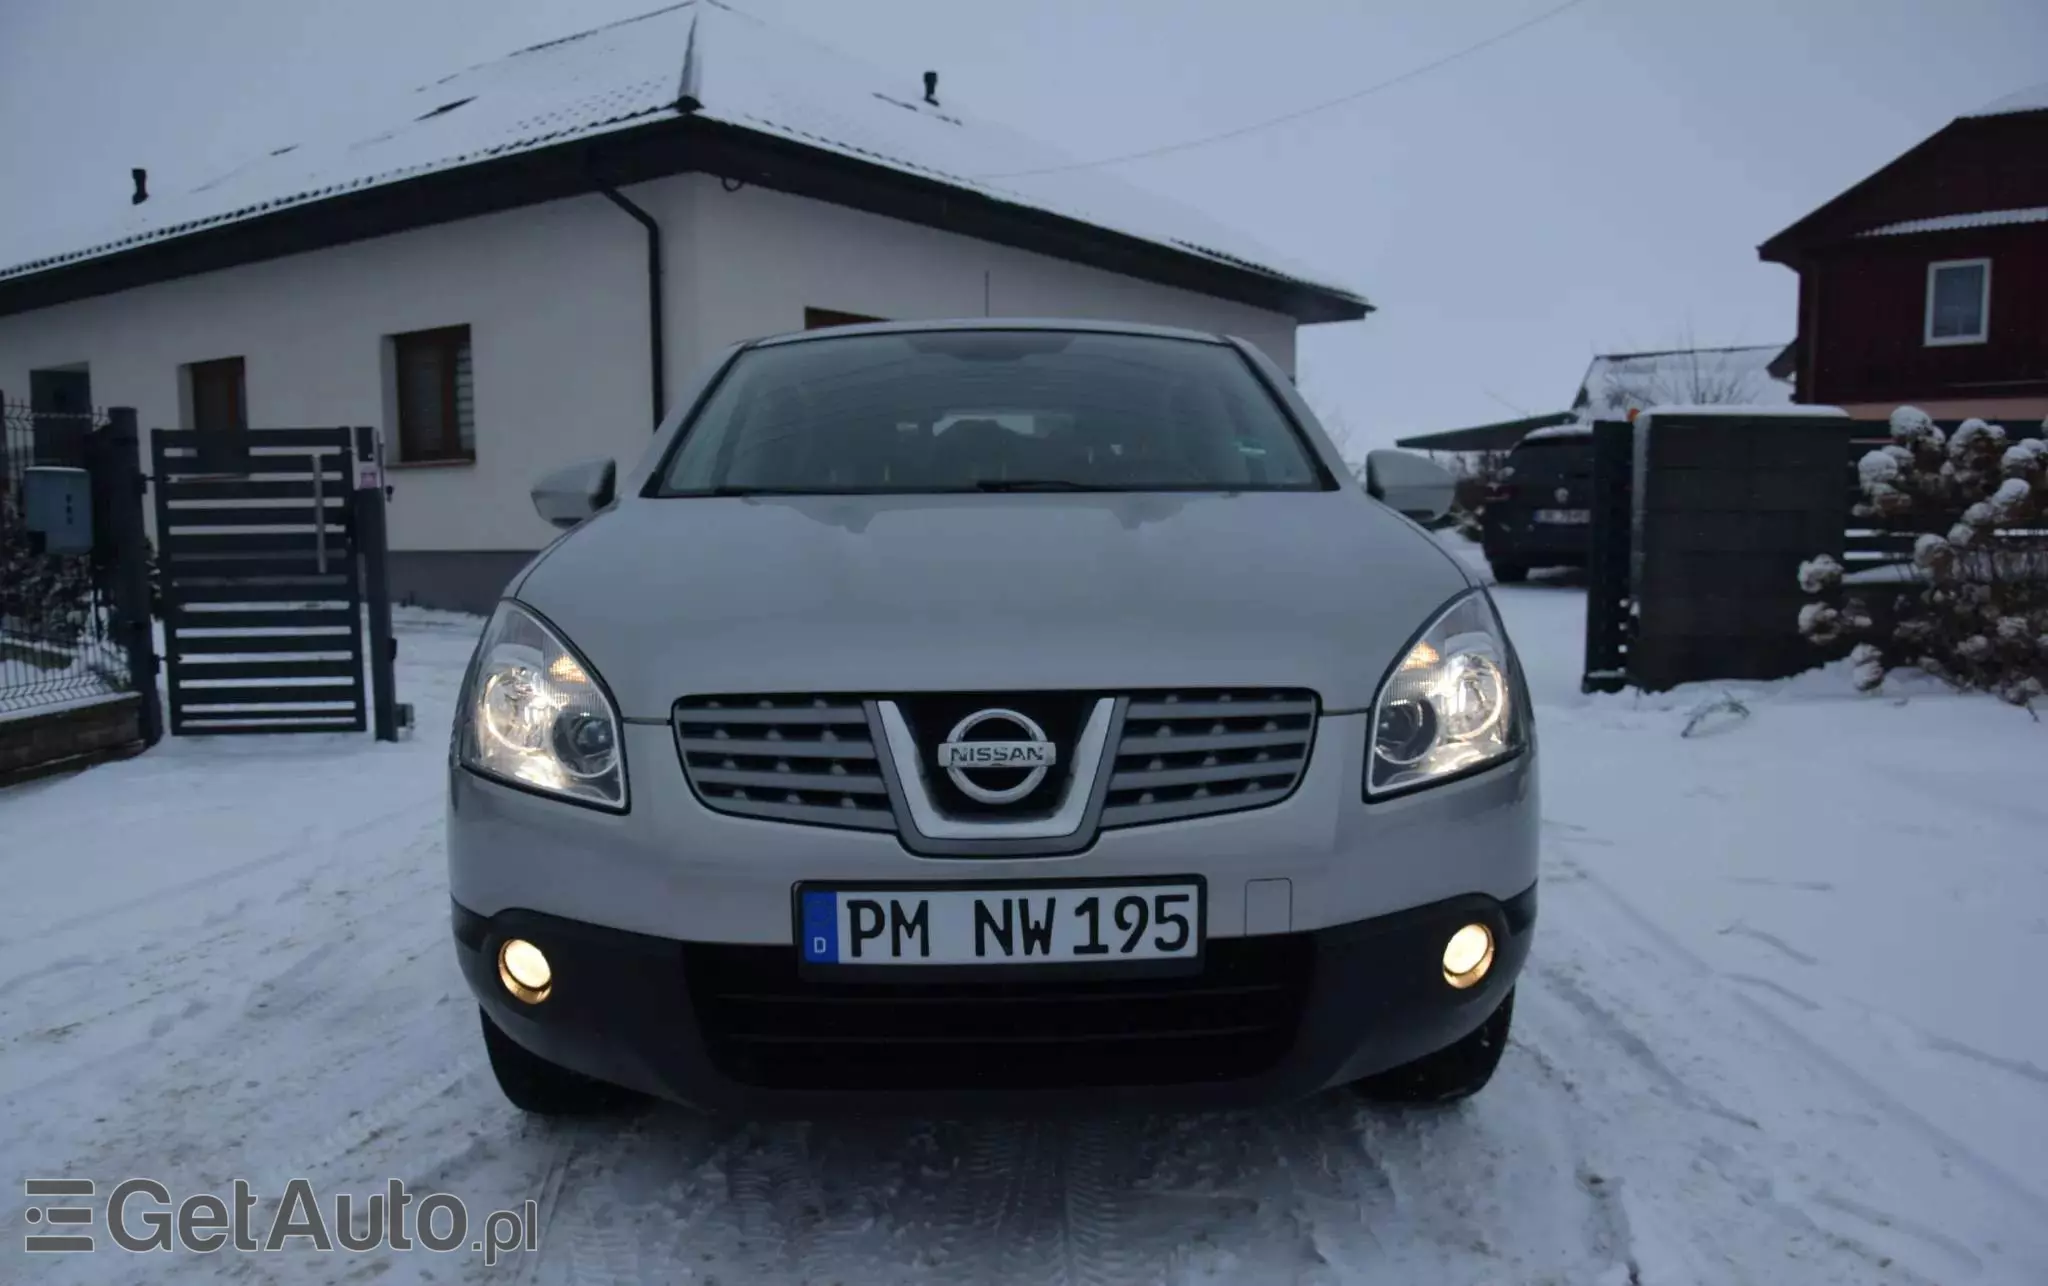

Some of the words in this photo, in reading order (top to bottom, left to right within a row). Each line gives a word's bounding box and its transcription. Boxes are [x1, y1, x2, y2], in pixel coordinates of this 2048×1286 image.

[951, 747, 1044, 762] NISSAN
[847, 899, 930, 957] PM
[813, 936, 826, 954] D
